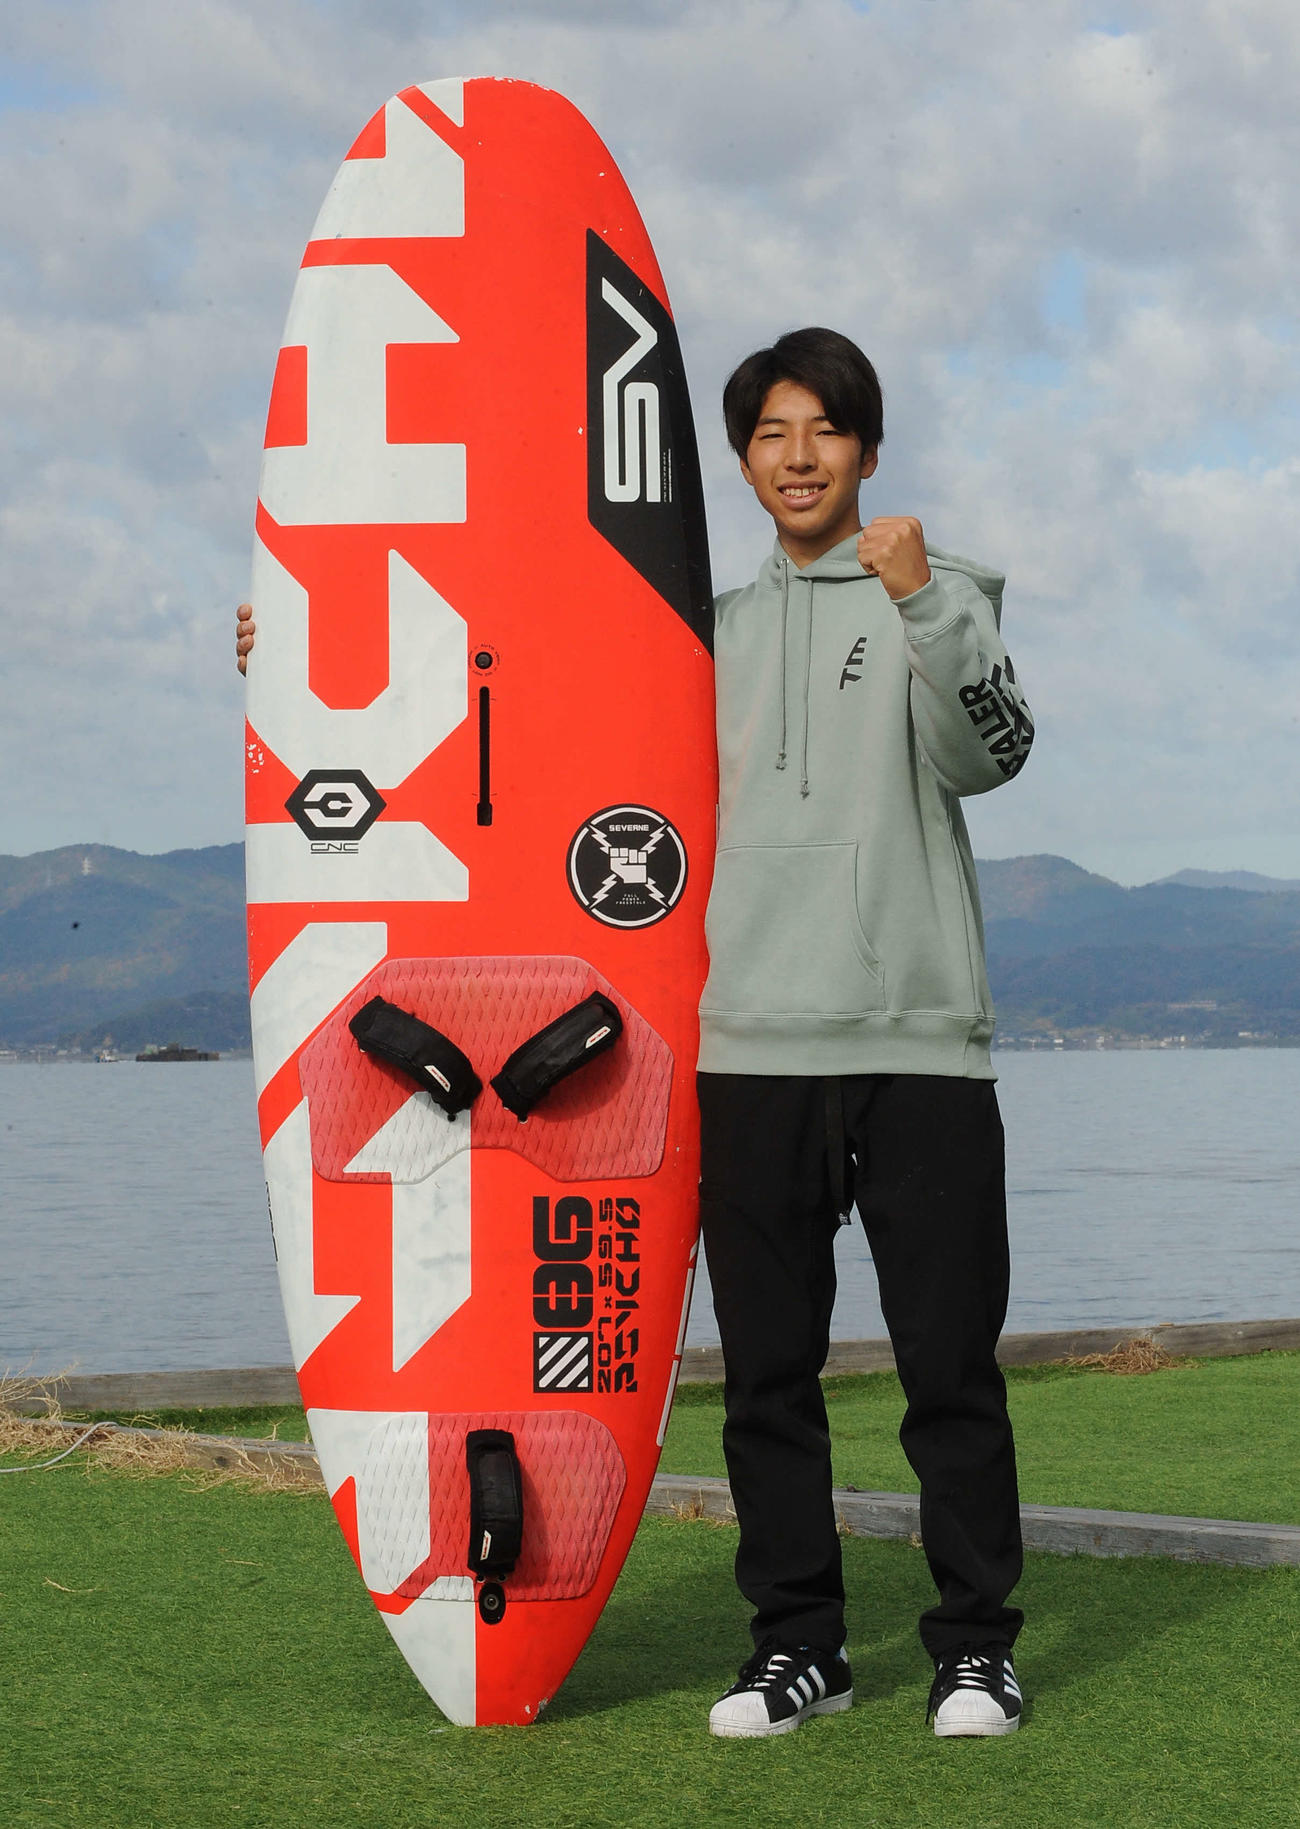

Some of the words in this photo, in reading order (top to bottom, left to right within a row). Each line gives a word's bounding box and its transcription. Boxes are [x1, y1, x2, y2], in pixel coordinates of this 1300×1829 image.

[310, 842, 359, 852] CNC
[608, 824, 650, 832] SEVERNE
[533, 1196, 593, 1328] 86
[598, 1197, 613, 1287] 59.5
[597, 1316, 612, 1393] 207
